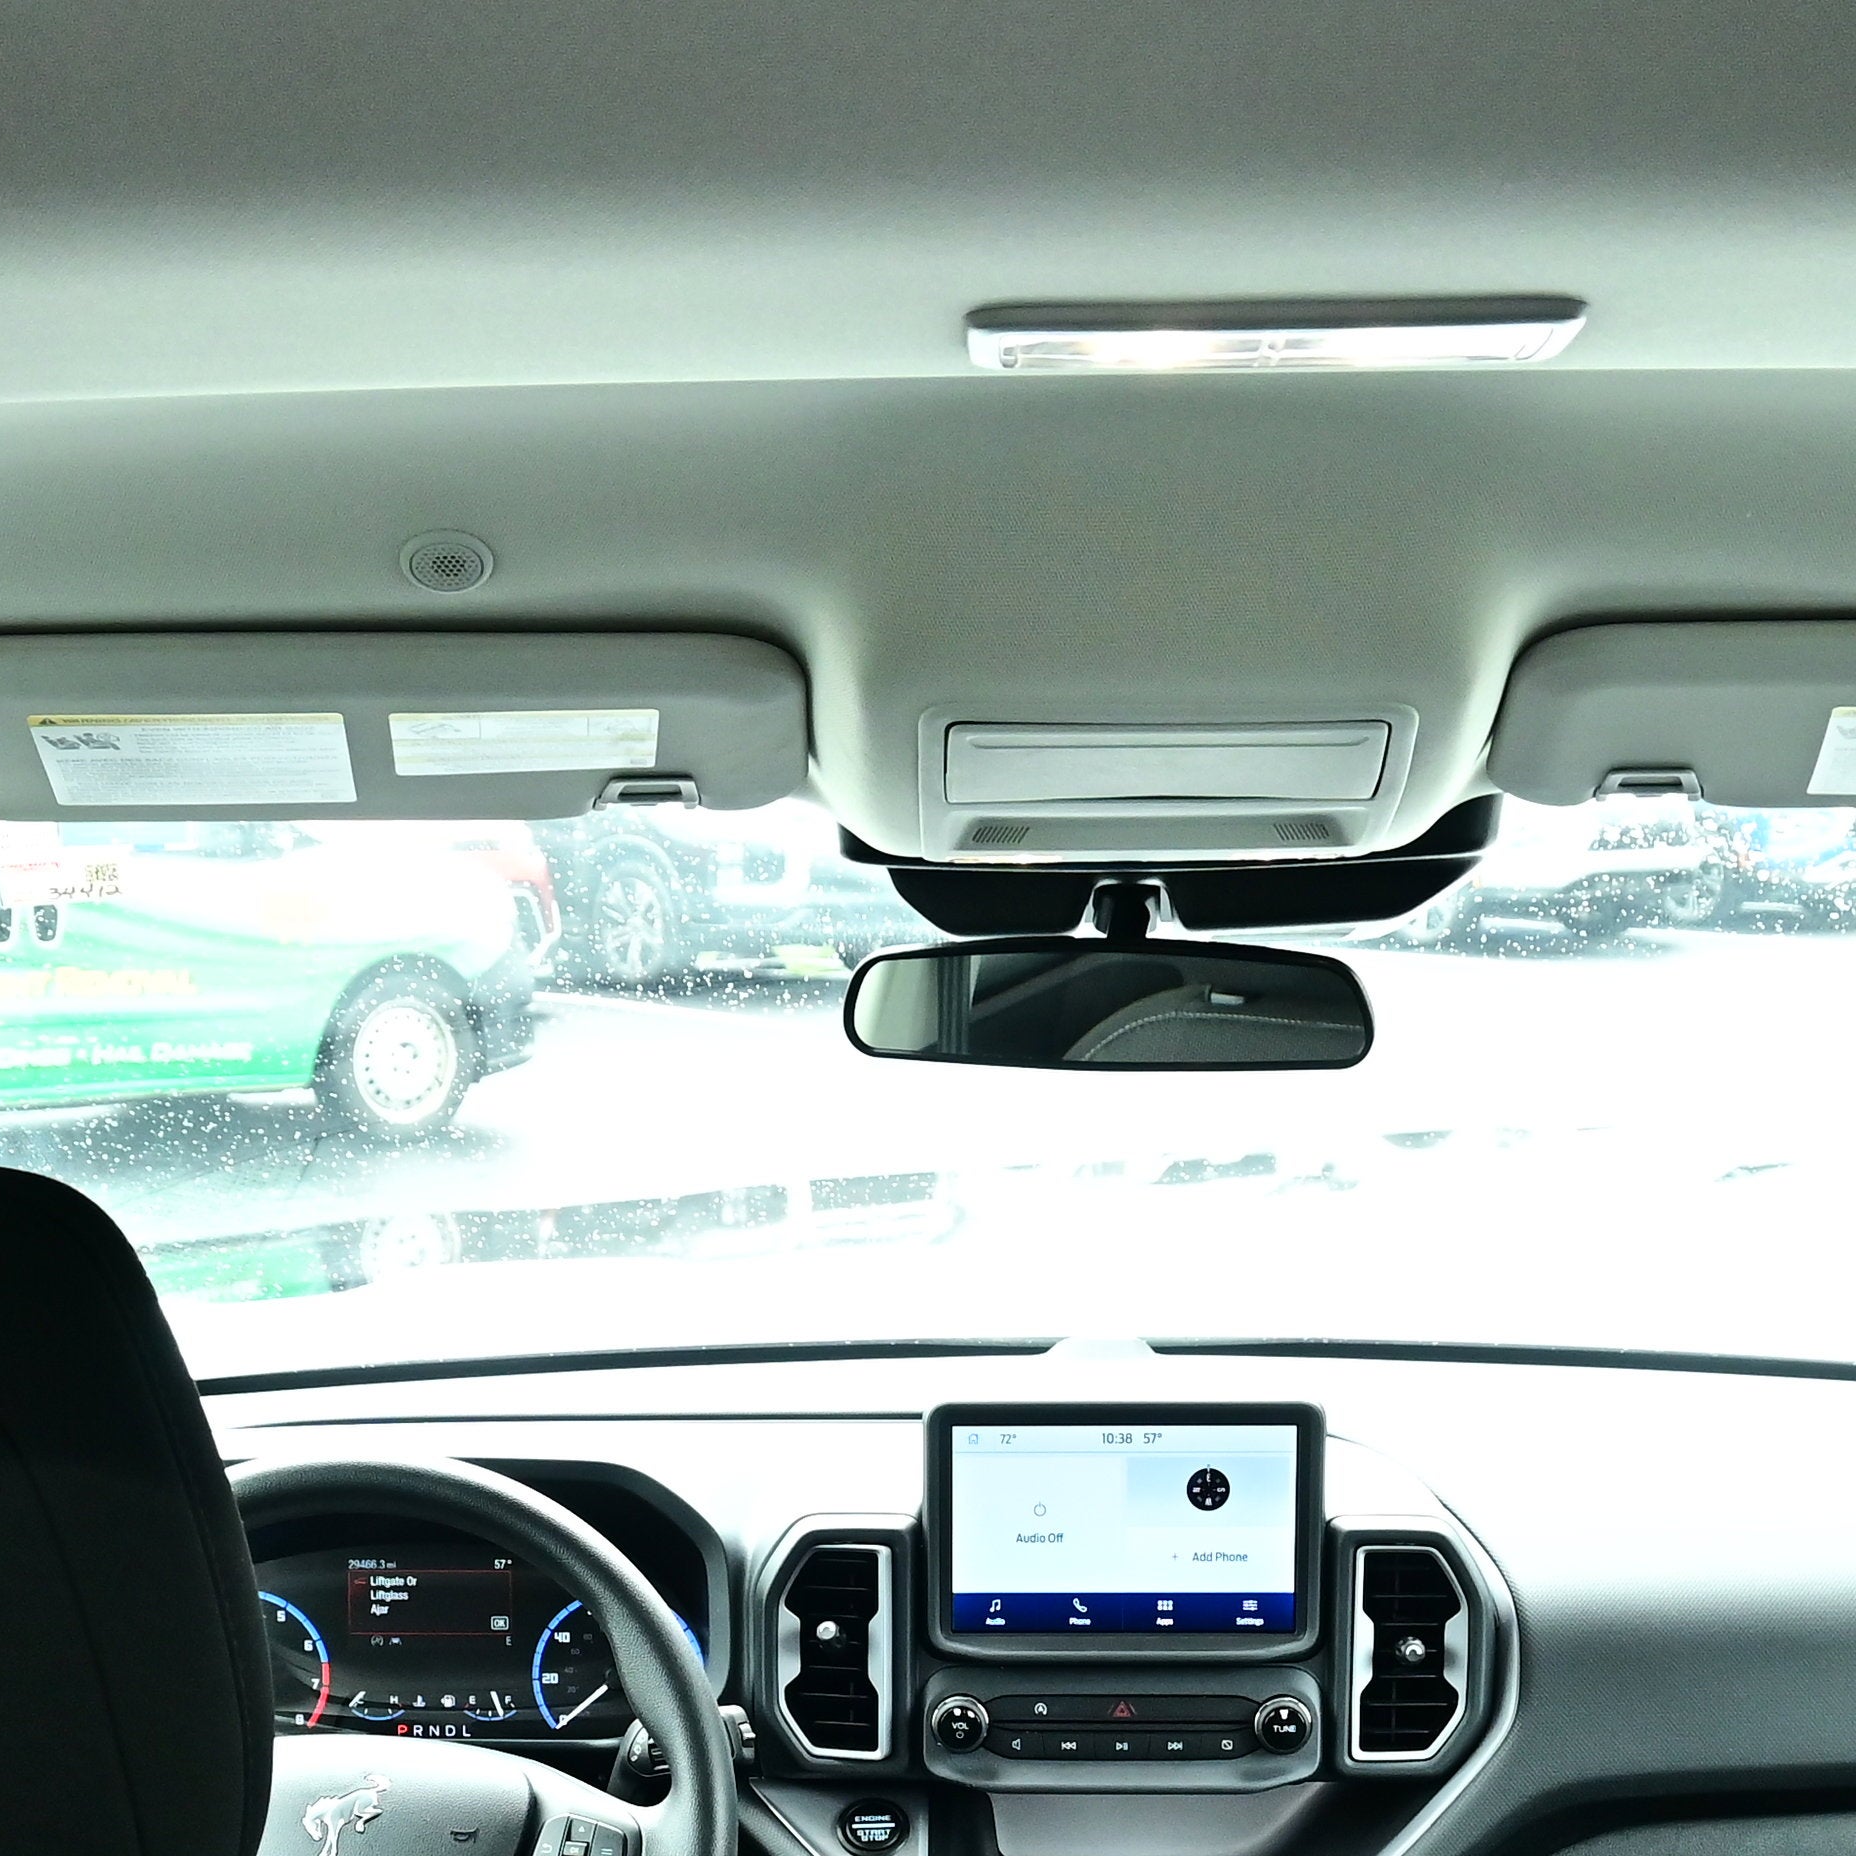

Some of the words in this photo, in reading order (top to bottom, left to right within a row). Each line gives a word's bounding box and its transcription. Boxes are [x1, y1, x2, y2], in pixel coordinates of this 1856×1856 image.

[999, 1433, 1017, 1445] 72°
[1101, 1432, 1133, 1445] 10:38
[1142, 1432, 1162, 1445] 57°
[1015, 1533, 1046, 1544] Audio
[1048, 1532, 1064, 1544] Off
[1191, 1551, 1213, 1562] Add
[1215, 1551, 1248, 1562] Phone
[348, 1559, 385, 1570] 29466.3
[370, 1576, 404, 1588] Liftgate
[406, 1576, 417, 1586] Or
[370, 1590, 409, 1602] Liftglass
[370, 1604, 389, 1616] Ajar
[276, 1610, 286, 1622] 5
[985, 1617, 1006, 1625] Audio
[1069, 1617, 1091, 1626] Phone
[493, 1619, 506, 1628] OK
[1156, 1617, 1174, 1627] Apps
[1236, 1617, 1264, 1627] Settings
[554, 1631, 571, 1643] 40
[304, 1639, 313, 1651] 6
[311, 1678, 320, 1690] 7
[542, 1673, 559, 1684] 20
[390, 1695, 398, 1704] H
[469, 1695, 476, 1704] E
[397, 1725, 408, 1735] P
[414, 1725, 423, 1736] R
[429, 1725, 440, 1736] N
[445, 1725, 456, 1736] D
[463, 1725, 471, 1737] L
[951, 1722, 969, 1730] VOL
[1273, 1725, 1297, 1733] TUNE
[854, 1814, 892, 1822] ENGINE
